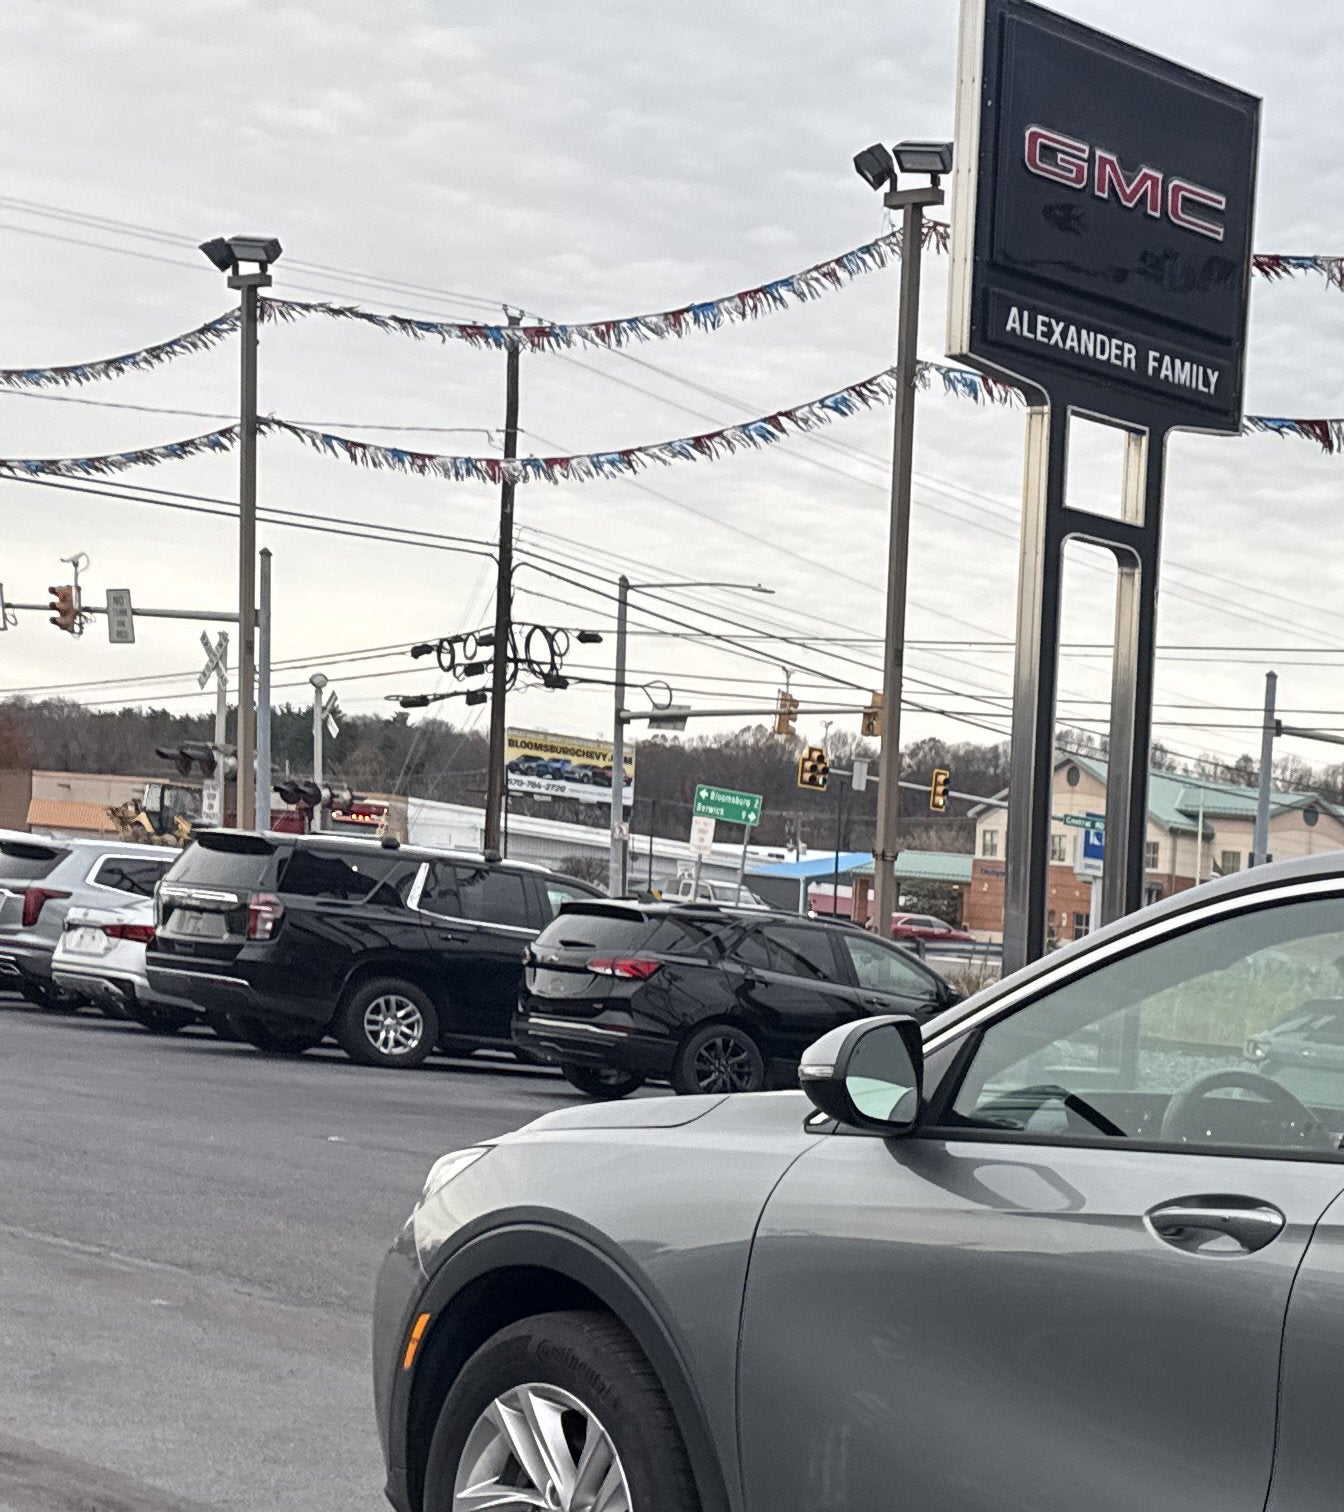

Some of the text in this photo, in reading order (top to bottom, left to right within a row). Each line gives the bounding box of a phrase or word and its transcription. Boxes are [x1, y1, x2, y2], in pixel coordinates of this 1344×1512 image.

[1024, 125, 1226, 241] GMC
[1005, 306, 1220, 395] ALEXANDER FAMILY
